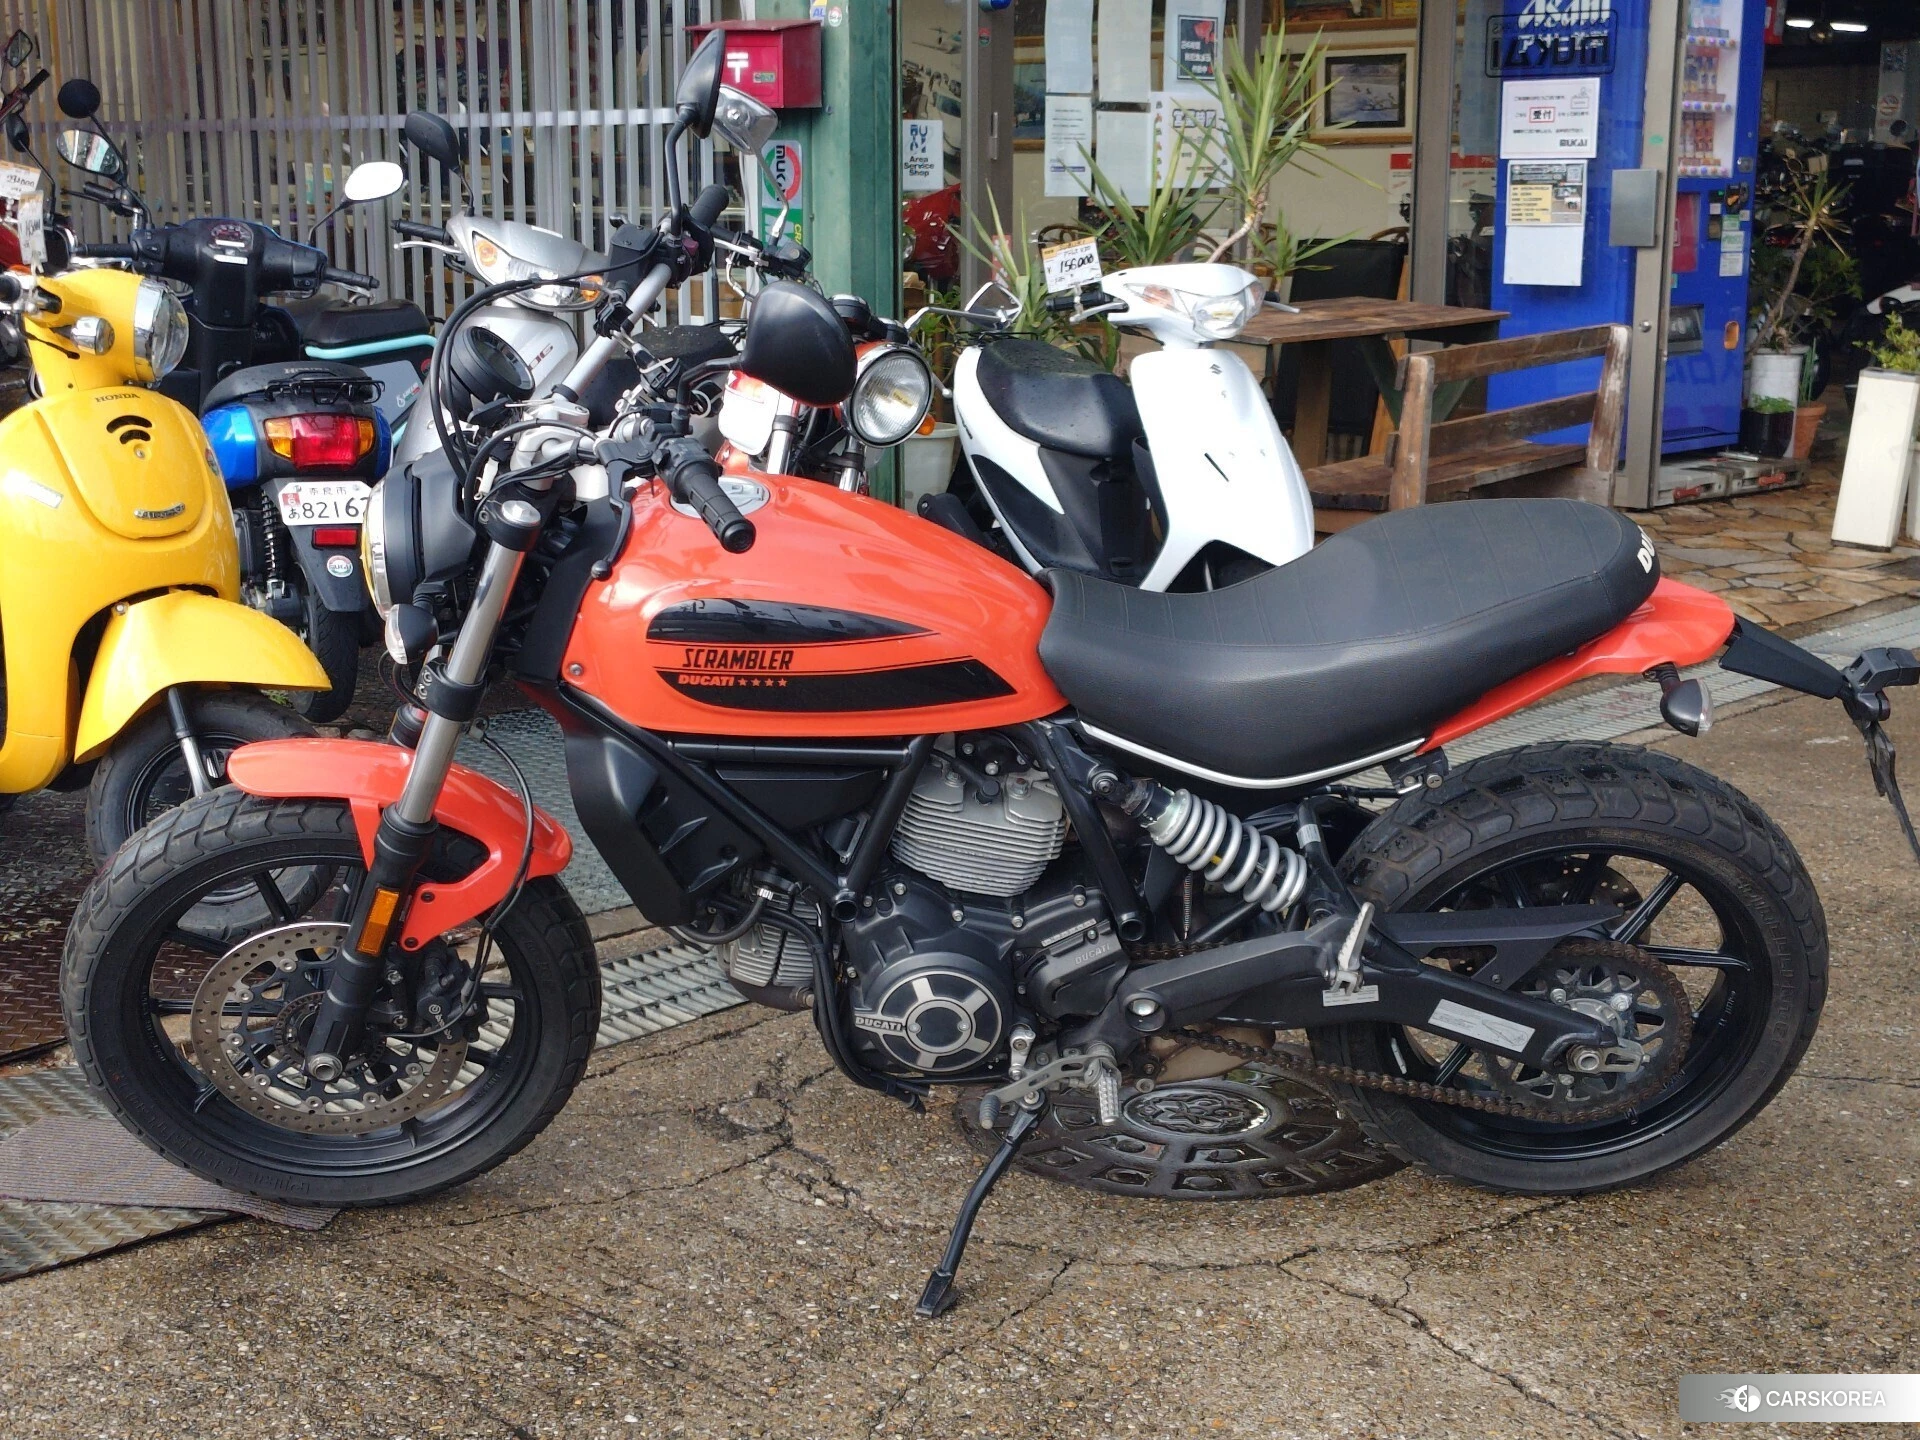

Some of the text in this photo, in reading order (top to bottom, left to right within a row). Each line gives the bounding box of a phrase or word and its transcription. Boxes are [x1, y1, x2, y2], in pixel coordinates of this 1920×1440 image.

[776, 145, 786, 201] MUK
[909, 168, 930, 177] Shop
[95, 392, 140, 402] HONDA
[288, 508, 300, 519] あ
[682, 648, 794, 670] SCRAMBLER
[678, 674, 735, 687] DUCATI
[856, 1016, 902, 1031] DUCATI
